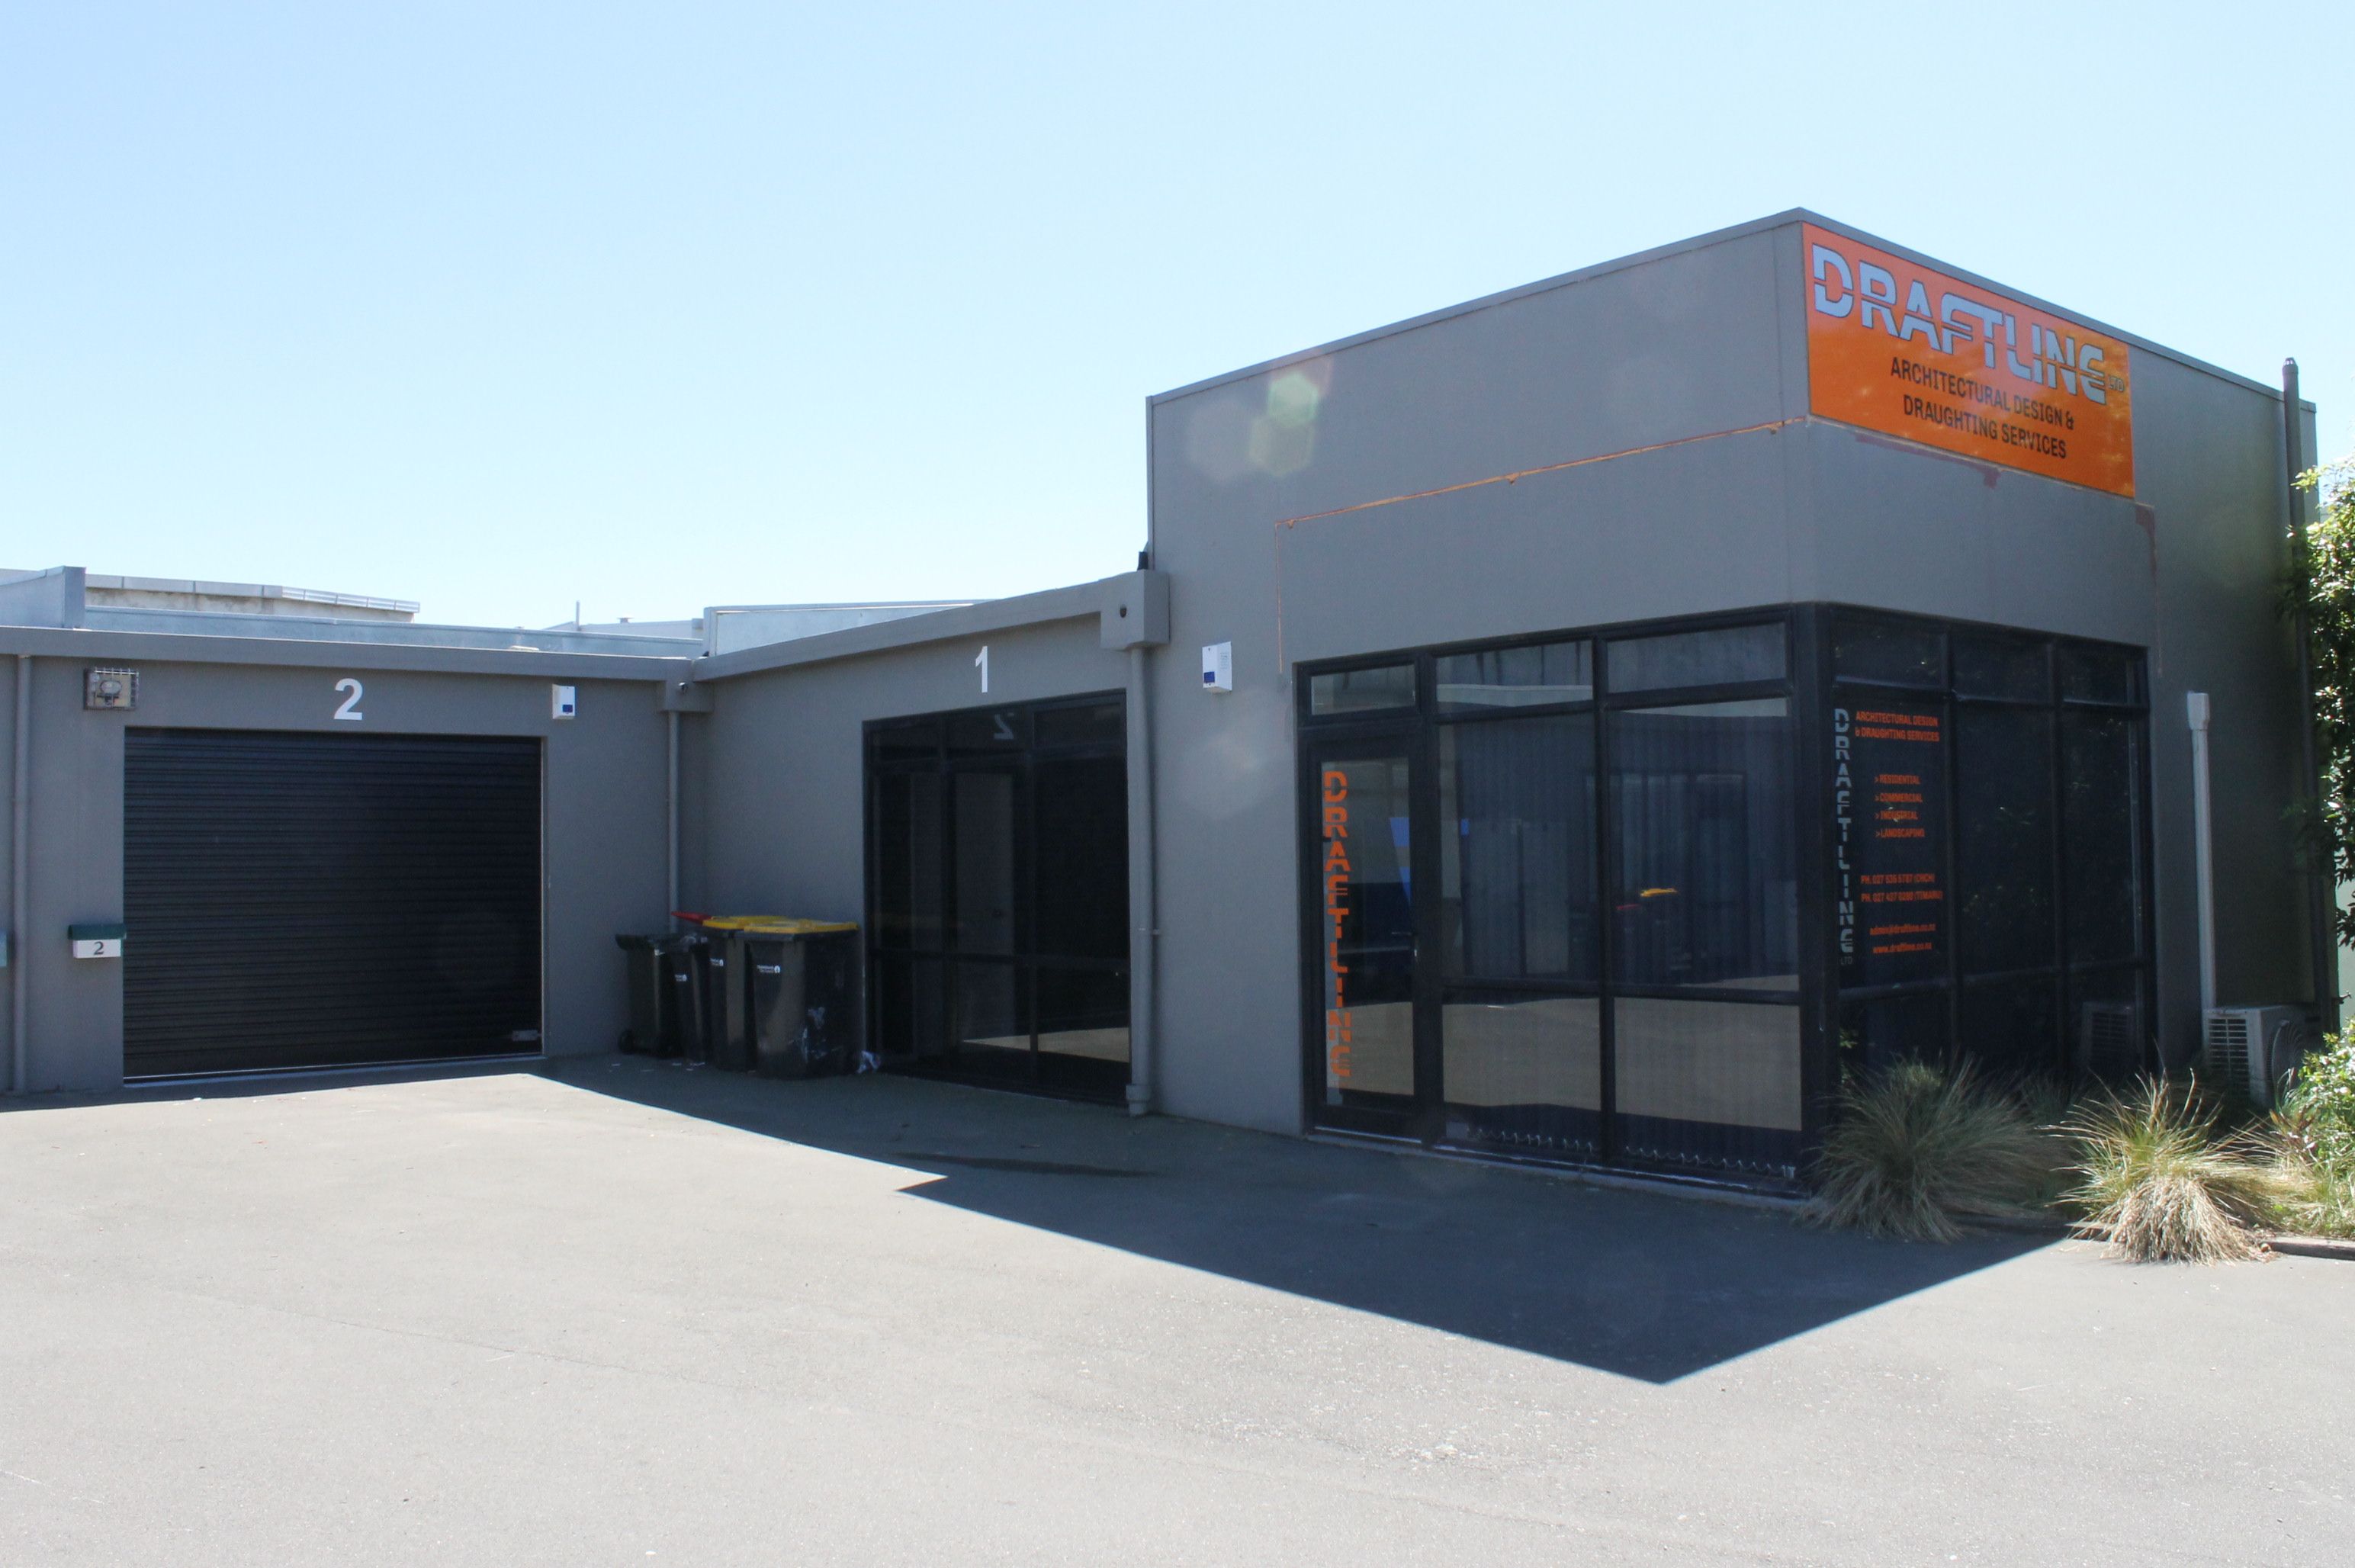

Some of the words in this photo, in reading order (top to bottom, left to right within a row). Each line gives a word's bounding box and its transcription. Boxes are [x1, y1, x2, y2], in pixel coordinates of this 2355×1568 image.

[1812, 243, 2107, 405] DRAFTLINE
[1891, 357, 2010, 411] ARCHITECTURAL
[2013, 395, 2063, 427] DESIGN
[2066, 410, 2075, 430] &
[1904, 394, 1997, 440] DRAUGHTING
[2001, 423, 2067, 459] SERVICES
[975, 645, 988, 693] 1
[334, 677, 363, 721] 2
[1855, 711, 1912, 725] ARCHITECTURAL
[1913, 715, 1939, 727] DESIGN
[1861, 727, 1906, 740] DRAUGHTING
[1907, 731, 1940, 742] SERVICES
[1879, 774, 1921, 785] RESIDENTIAL
[1879, 792, 1923, 803] COMMERCIAL
[1834, 708, 1854, 953] DRAFTLINE
[93, 941, 104, 955] 2
